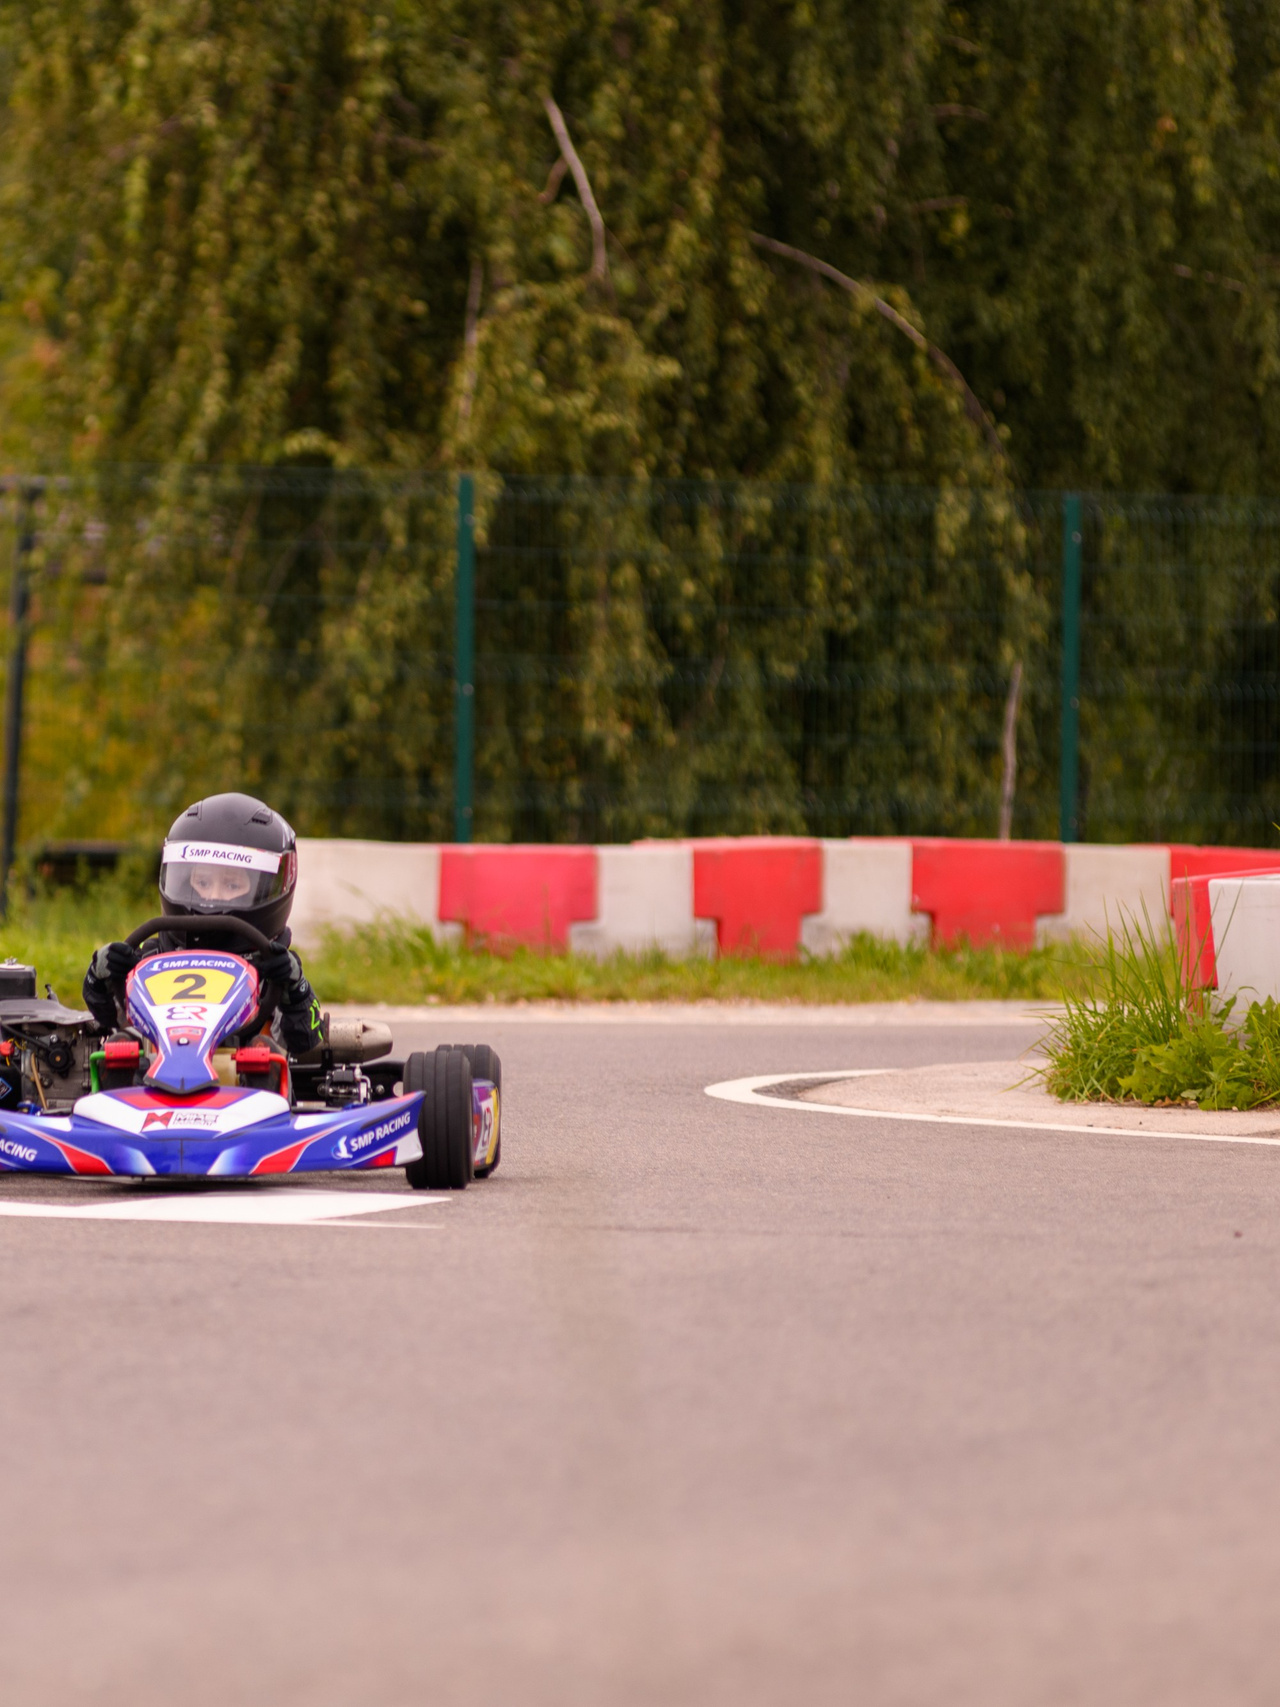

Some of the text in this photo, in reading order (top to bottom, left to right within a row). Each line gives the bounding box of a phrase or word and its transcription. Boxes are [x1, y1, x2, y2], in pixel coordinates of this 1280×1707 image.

[189, 848, 253, 864] SMP RACING
[162, 960, 236, 969] SMP RACING
[171, 974, 207, 1000] 2
[350, 1111, 411, 1152] SMP RACING
